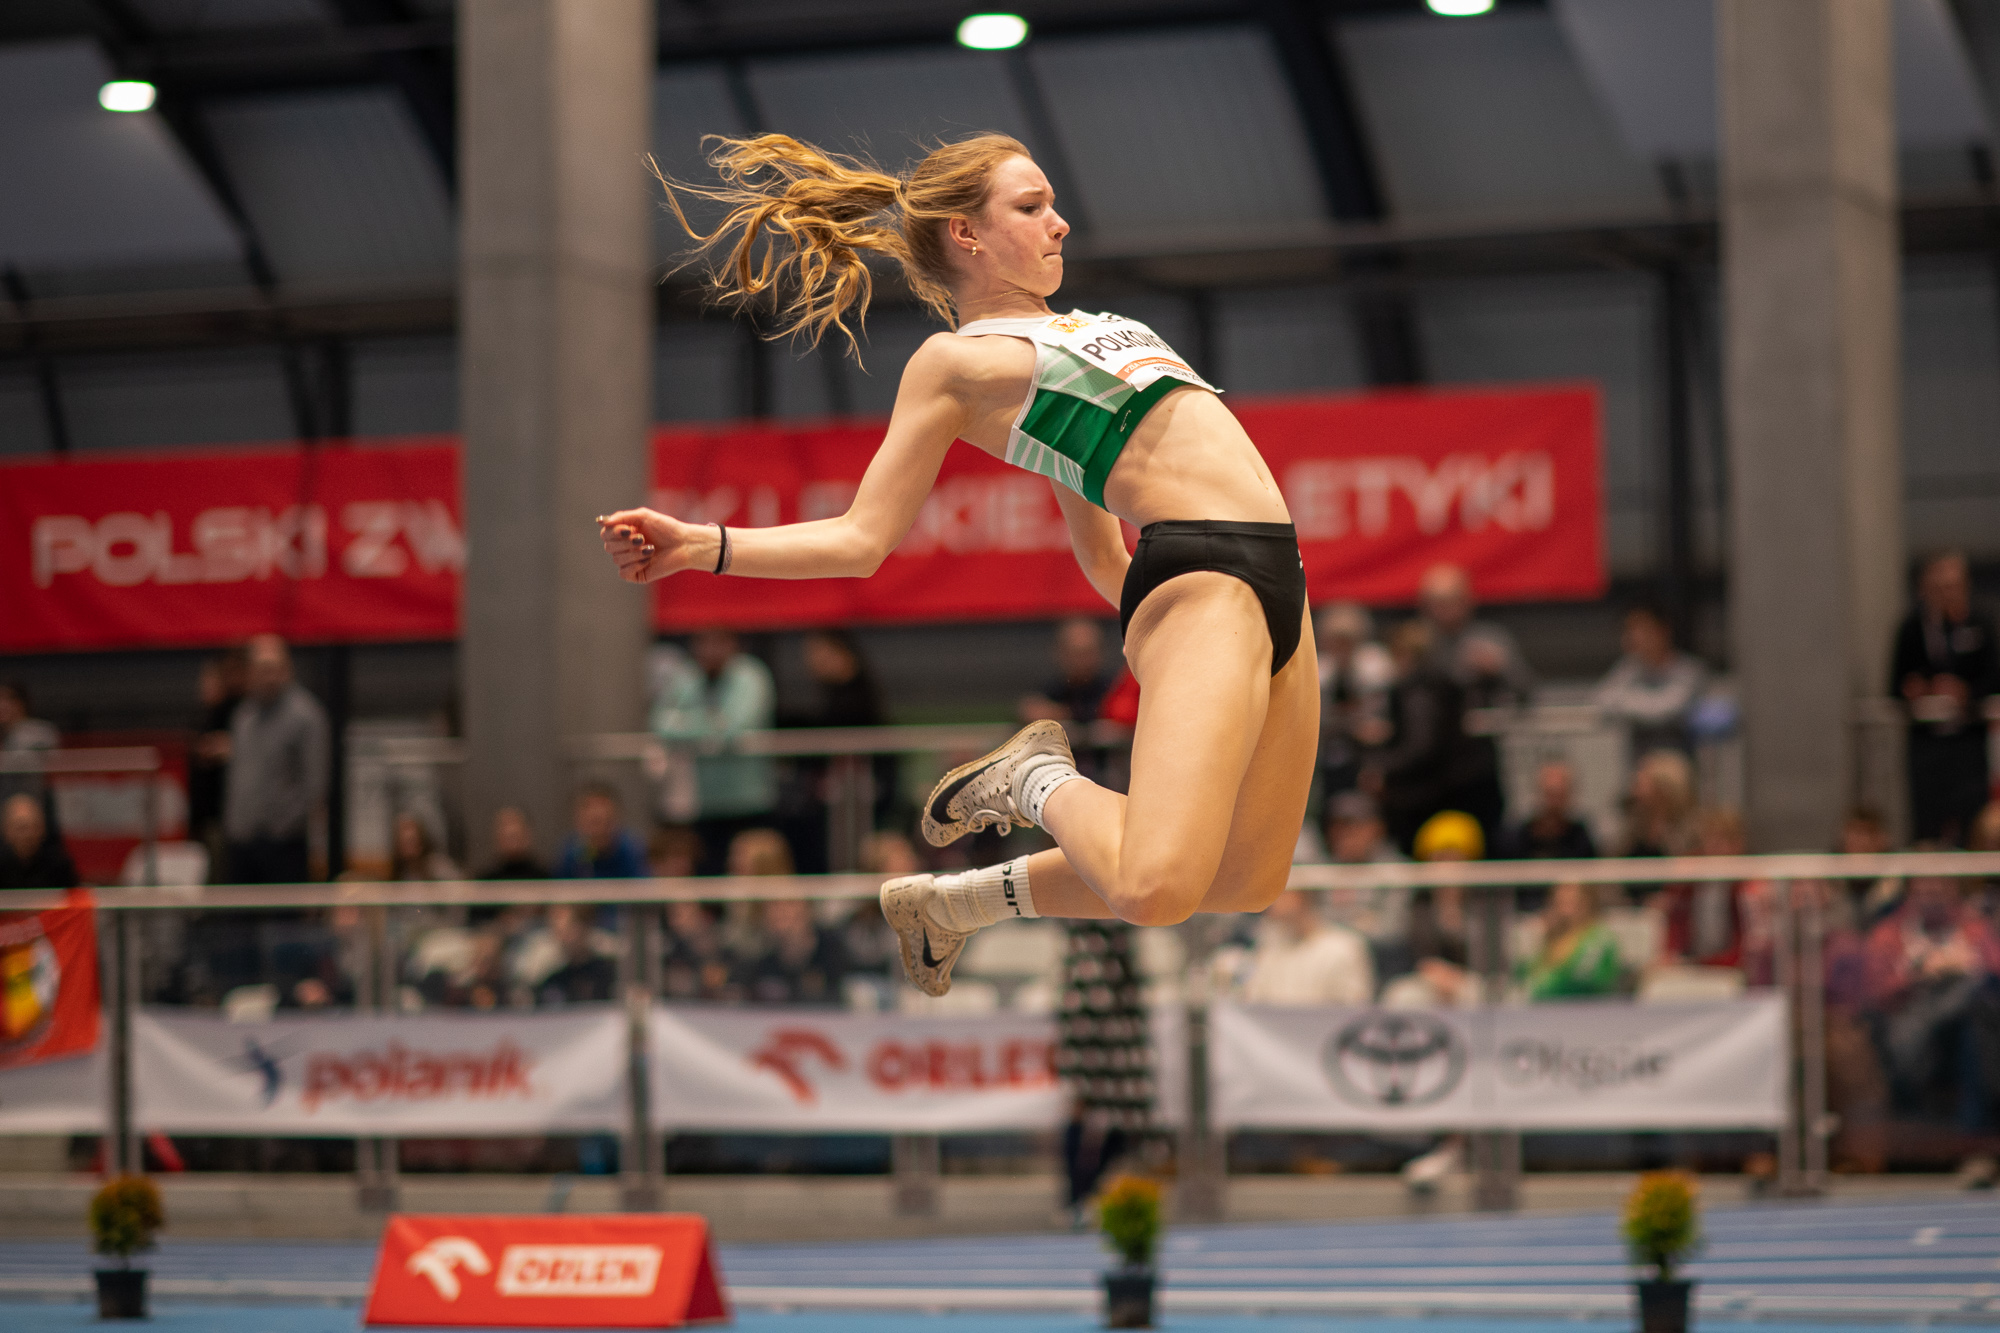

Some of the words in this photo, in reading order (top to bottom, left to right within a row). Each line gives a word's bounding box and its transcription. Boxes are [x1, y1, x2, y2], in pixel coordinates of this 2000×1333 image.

[32, 504, 326, 585] POLSKI
[343, 498, 466, 577] ZW
[1284, 450, 1553, 541] ETYKI
[300, 1035, 535, 1114] polanik
[868, 1034, 1062, 1092] ORLE
[517, 1258, 641, 1285] ORLEN
